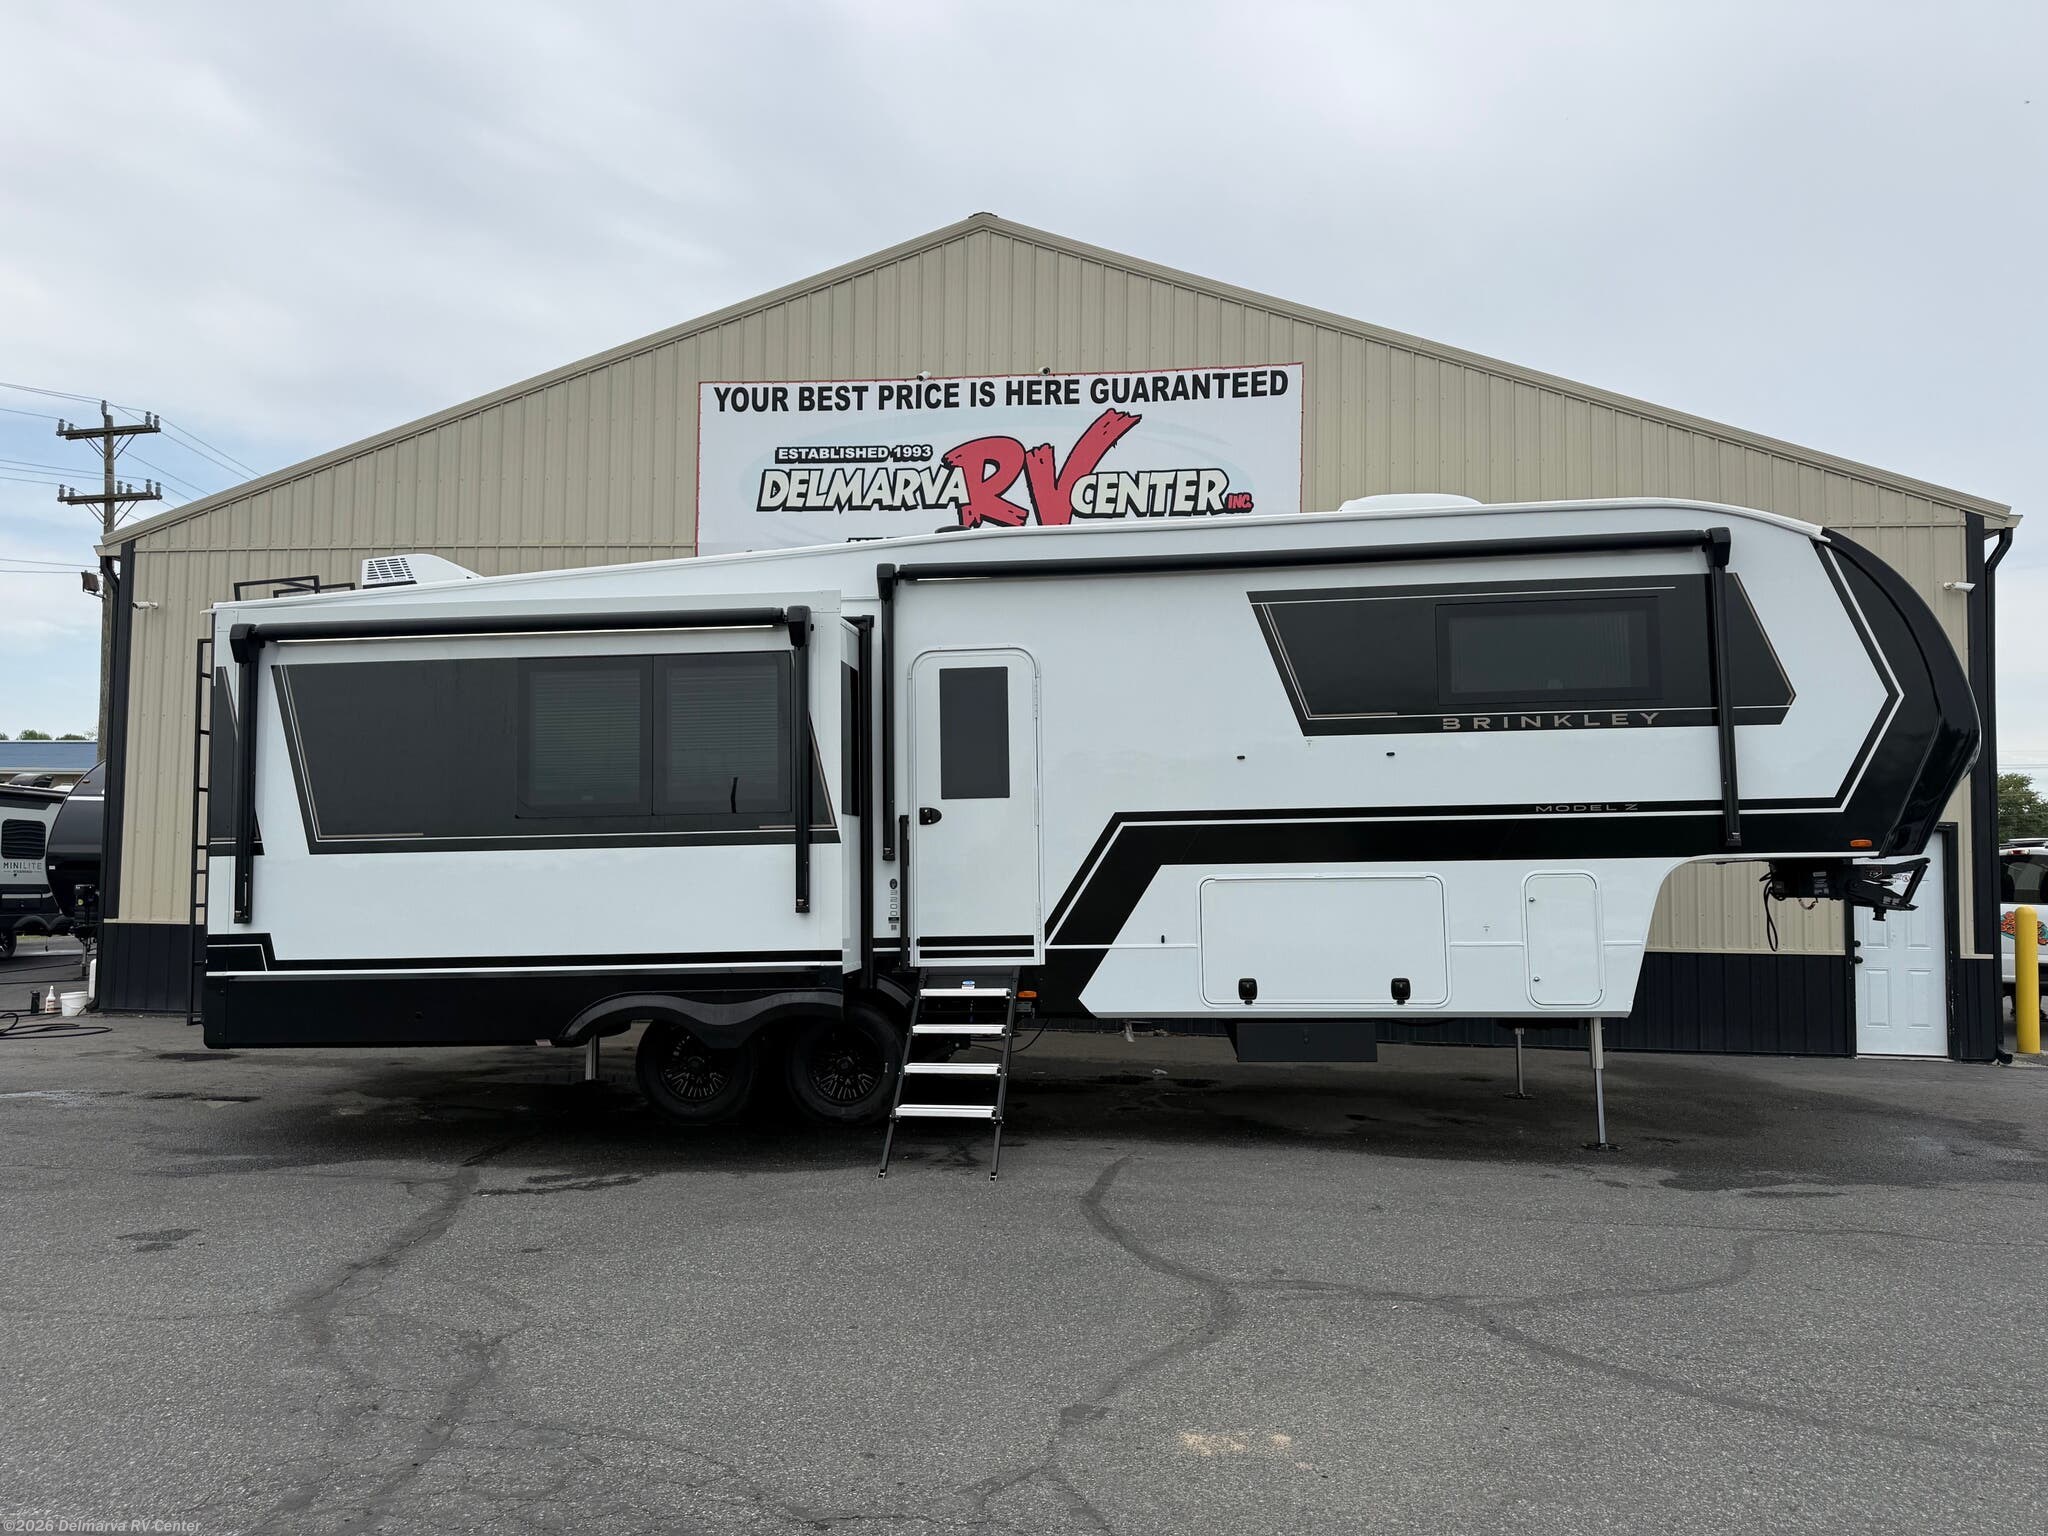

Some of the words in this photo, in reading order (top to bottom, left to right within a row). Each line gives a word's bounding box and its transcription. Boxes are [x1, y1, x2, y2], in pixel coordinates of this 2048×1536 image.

[713, 386, 789, 413] YOUR
[799, 385, 869, 411] BEST
[878, 382, 960, 410] PRICE
[970, 381, 996, 408] IS
[1005, 379, 1081, 406] HERE
[1090, 370, 1289, 404] GUARANTEED
[776, 446, 889, 462] ESTABLISHED
[892, 445, 933, 460] 1993
[757, 466, 971, 513] DELMARVA
[942, 408, 1142, 528] RV
[1070, 468, 1229, 517] CENTER
[1442, 712, 1660, 730] BRINKLEY
[1535, 803, 1618, 813] MODEL
[1624, 803, 1639, 811] Z
[3, 861, 43, 870] MINILITE
